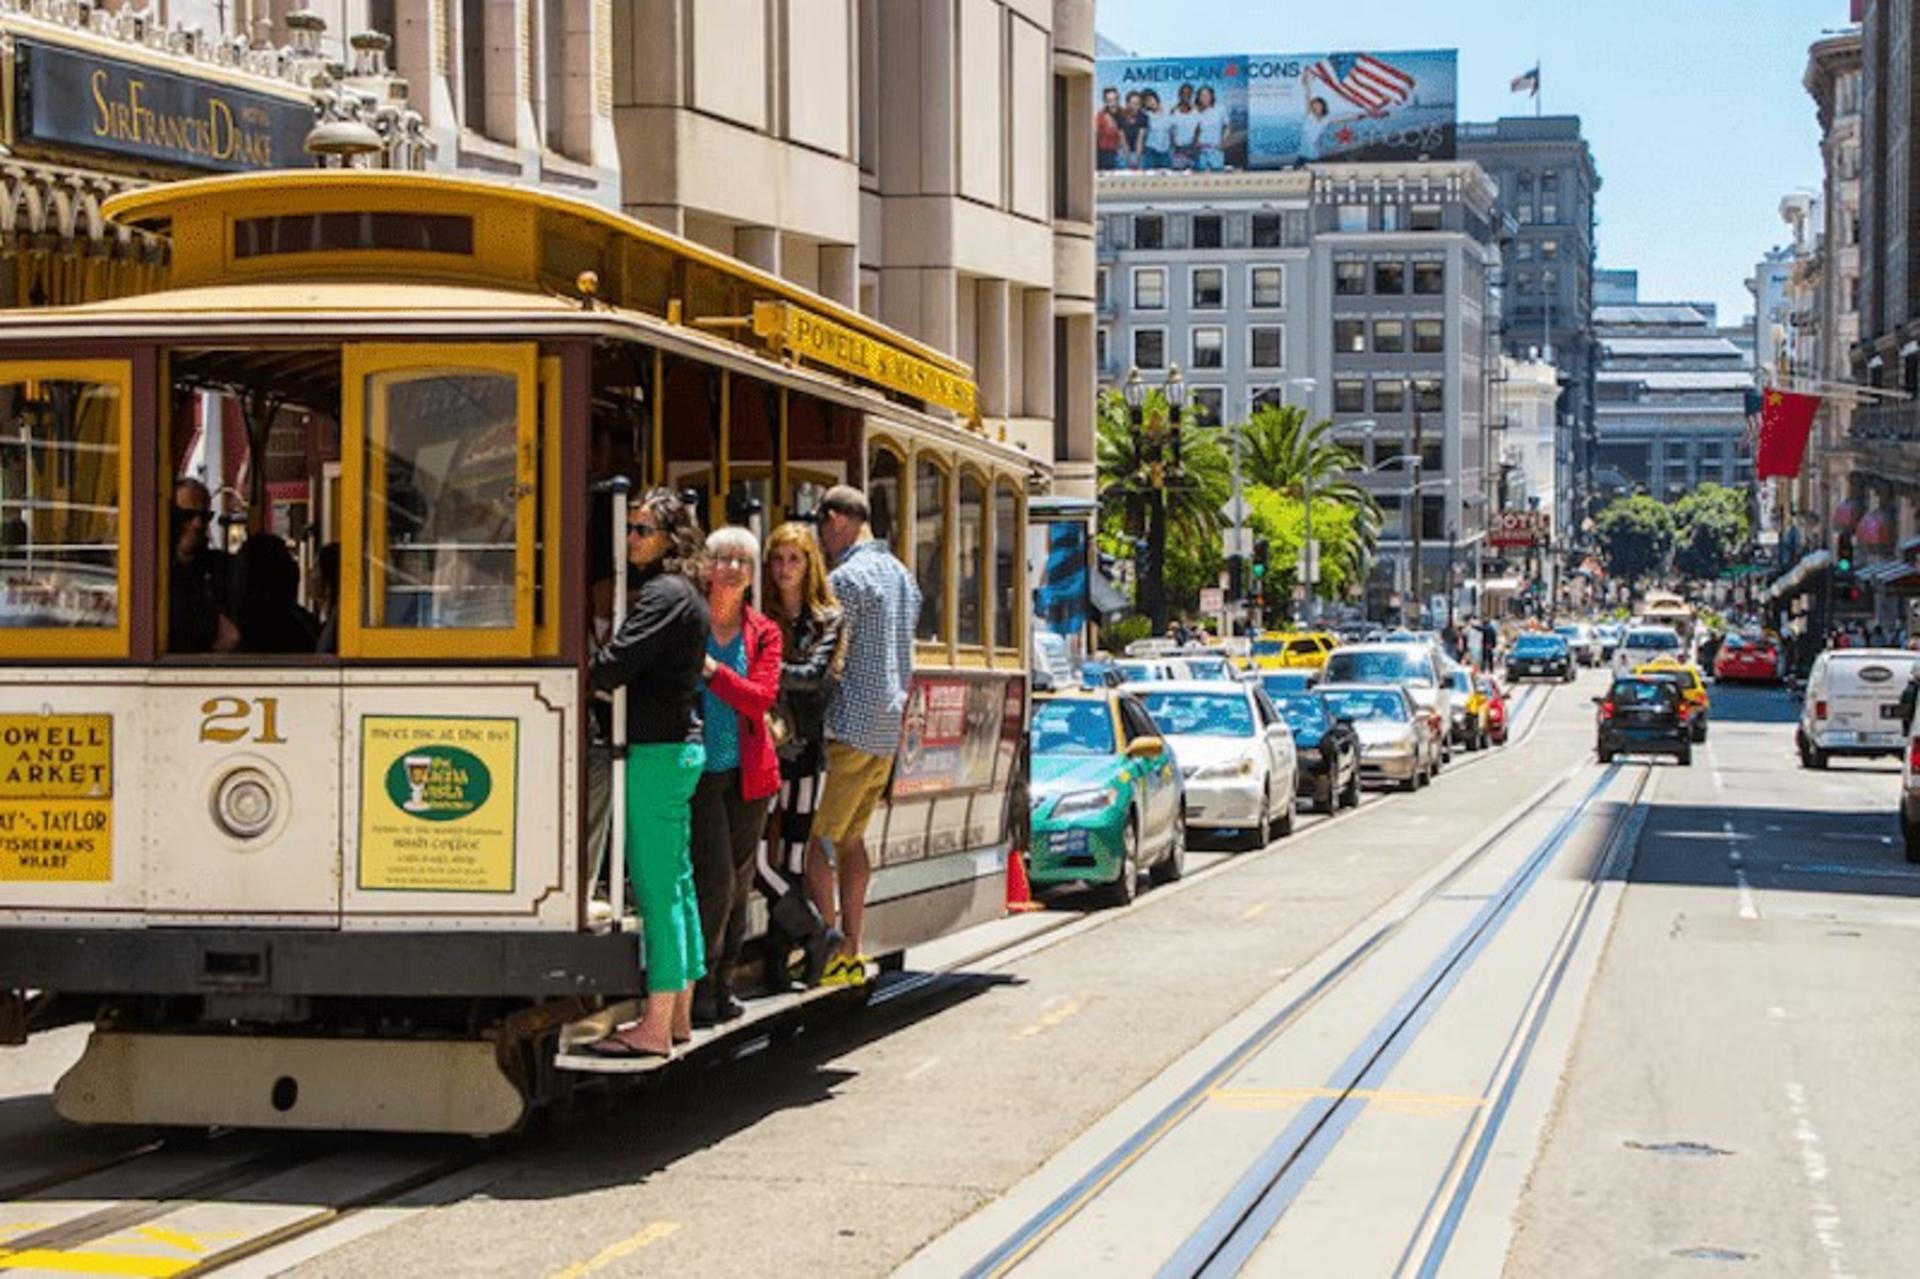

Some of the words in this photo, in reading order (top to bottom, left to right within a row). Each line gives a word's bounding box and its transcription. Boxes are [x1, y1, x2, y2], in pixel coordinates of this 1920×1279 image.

[1122, 64, 1223, 83] AMERICAN
[797, 317, 870, 370] POWELL
[198, 695, 288, 744] 21
[0, 727, 103, 747] OWELL
[16, 748, 76, 763] AND
[5, 764, 107, 783] ARKET
[0, 810, 17, 831] AY
[42, 810, 107, 832] TAYLOR
[19, 854, 69, 869] WHARF
